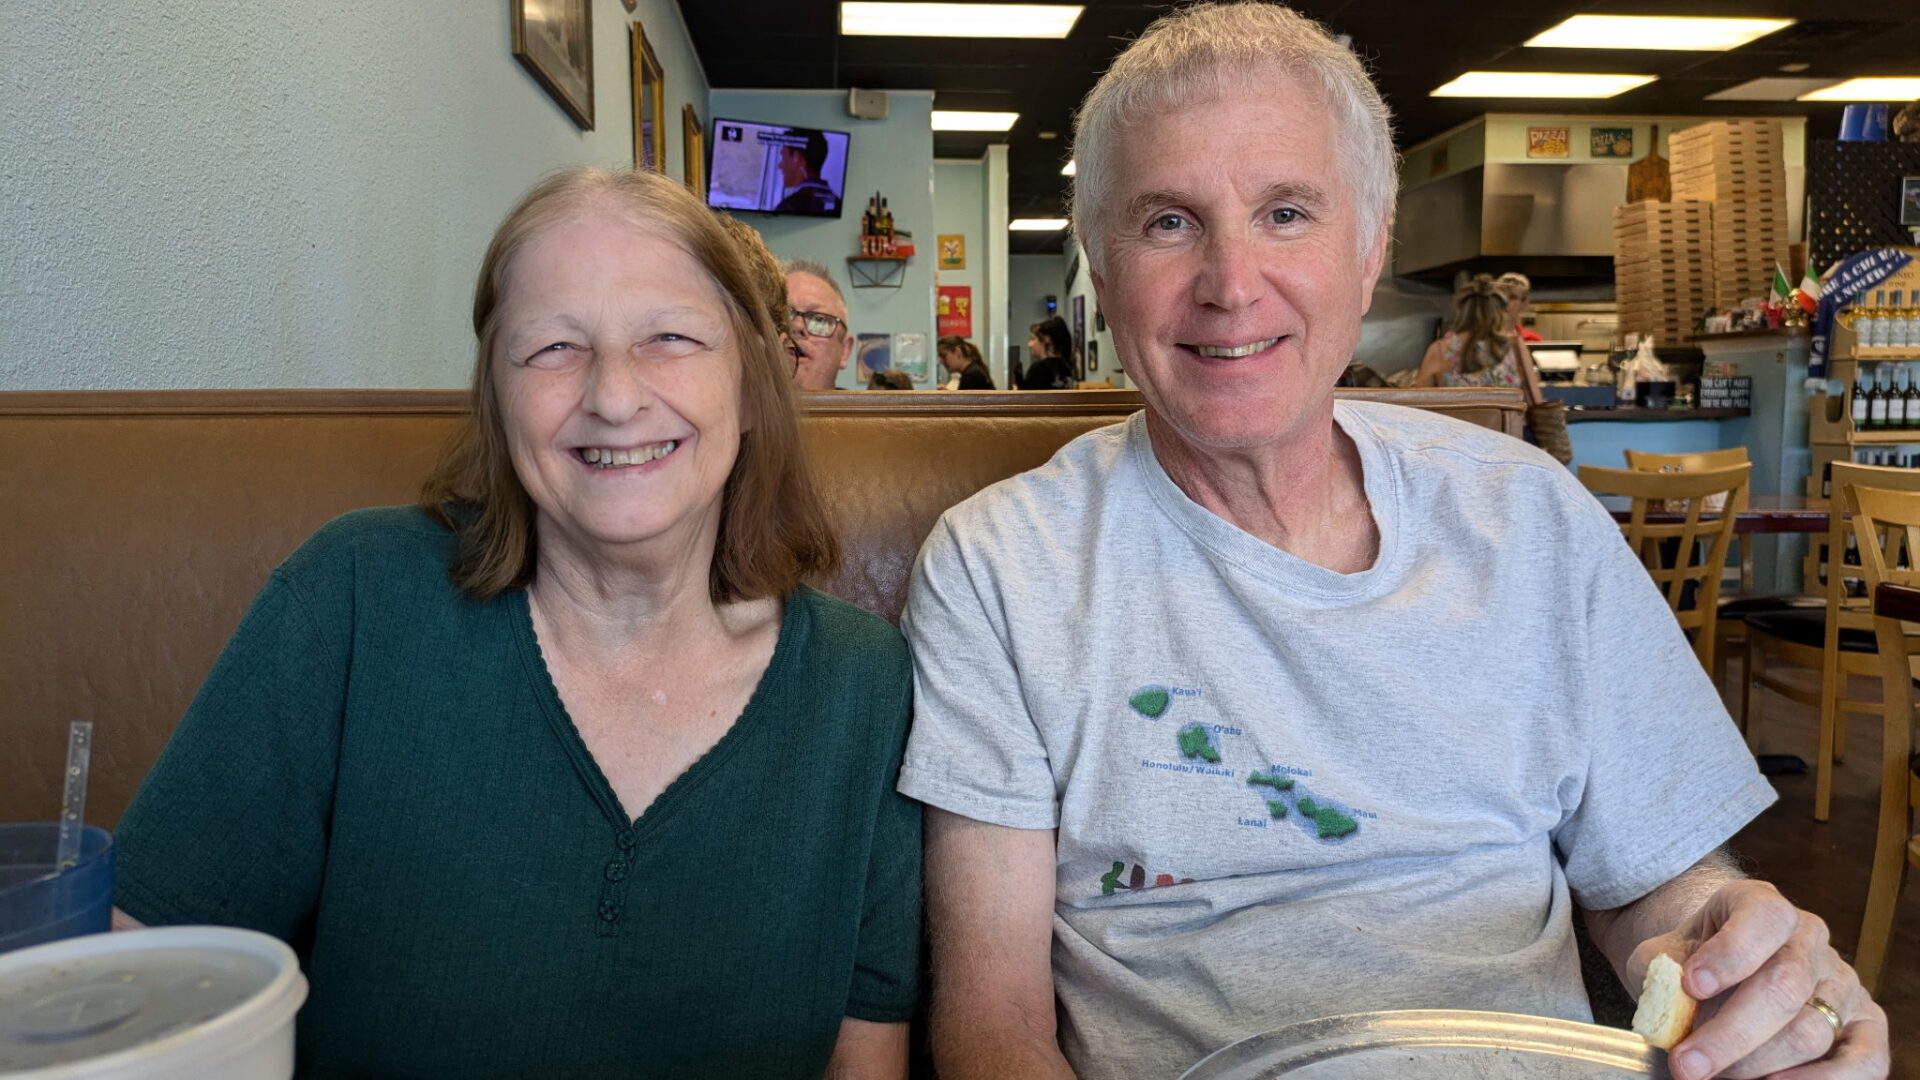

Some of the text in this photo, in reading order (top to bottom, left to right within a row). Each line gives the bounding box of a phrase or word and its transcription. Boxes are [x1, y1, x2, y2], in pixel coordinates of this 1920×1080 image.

[1530, 131, 1567, 146] PIZZA
[1701, 378, 1749, 388] YOU CAN'T MAKE
[1700, 389, 1749, 398] EVERYONE HAPPY
[1172, 687, 1201, 697] Kaua'i
[1213, 725, 1242, 736] O'ahu
[1142, 760, 1235, 777] Honolulu/Waikiki
[1271, 764, 1313, 777] Molokai
[1353, 808, 1377, 819] Maui
[1238, 816, 1267, 828] Lanai
